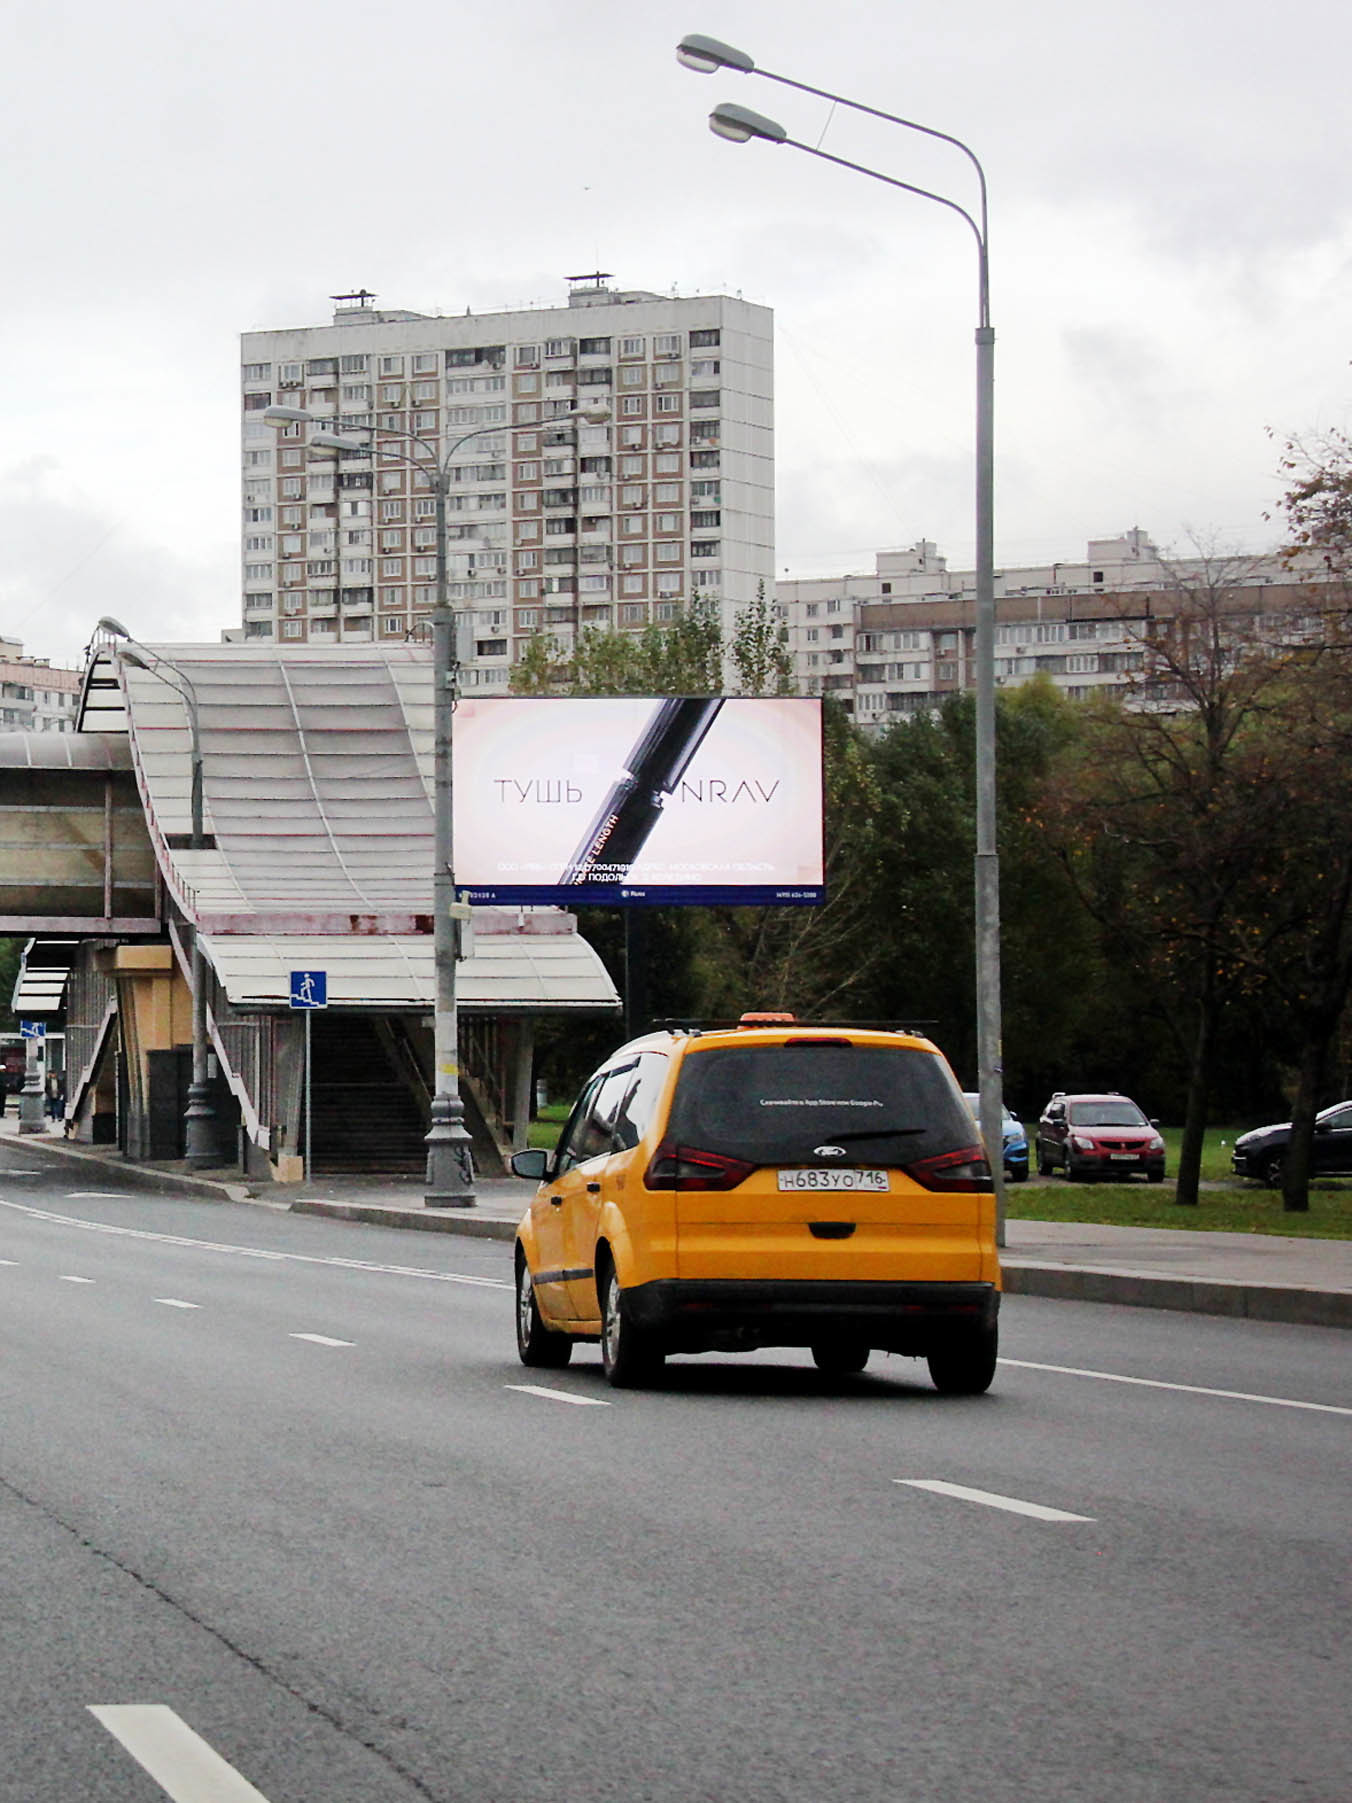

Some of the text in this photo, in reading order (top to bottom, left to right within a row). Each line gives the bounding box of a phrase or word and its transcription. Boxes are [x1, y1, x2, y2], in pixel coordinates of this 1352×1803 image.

[493, 779, 583, 803] ТУШЬ
[682, 779, 780, 803] NRAV
[591, 814, 619, 856] LENGTH
